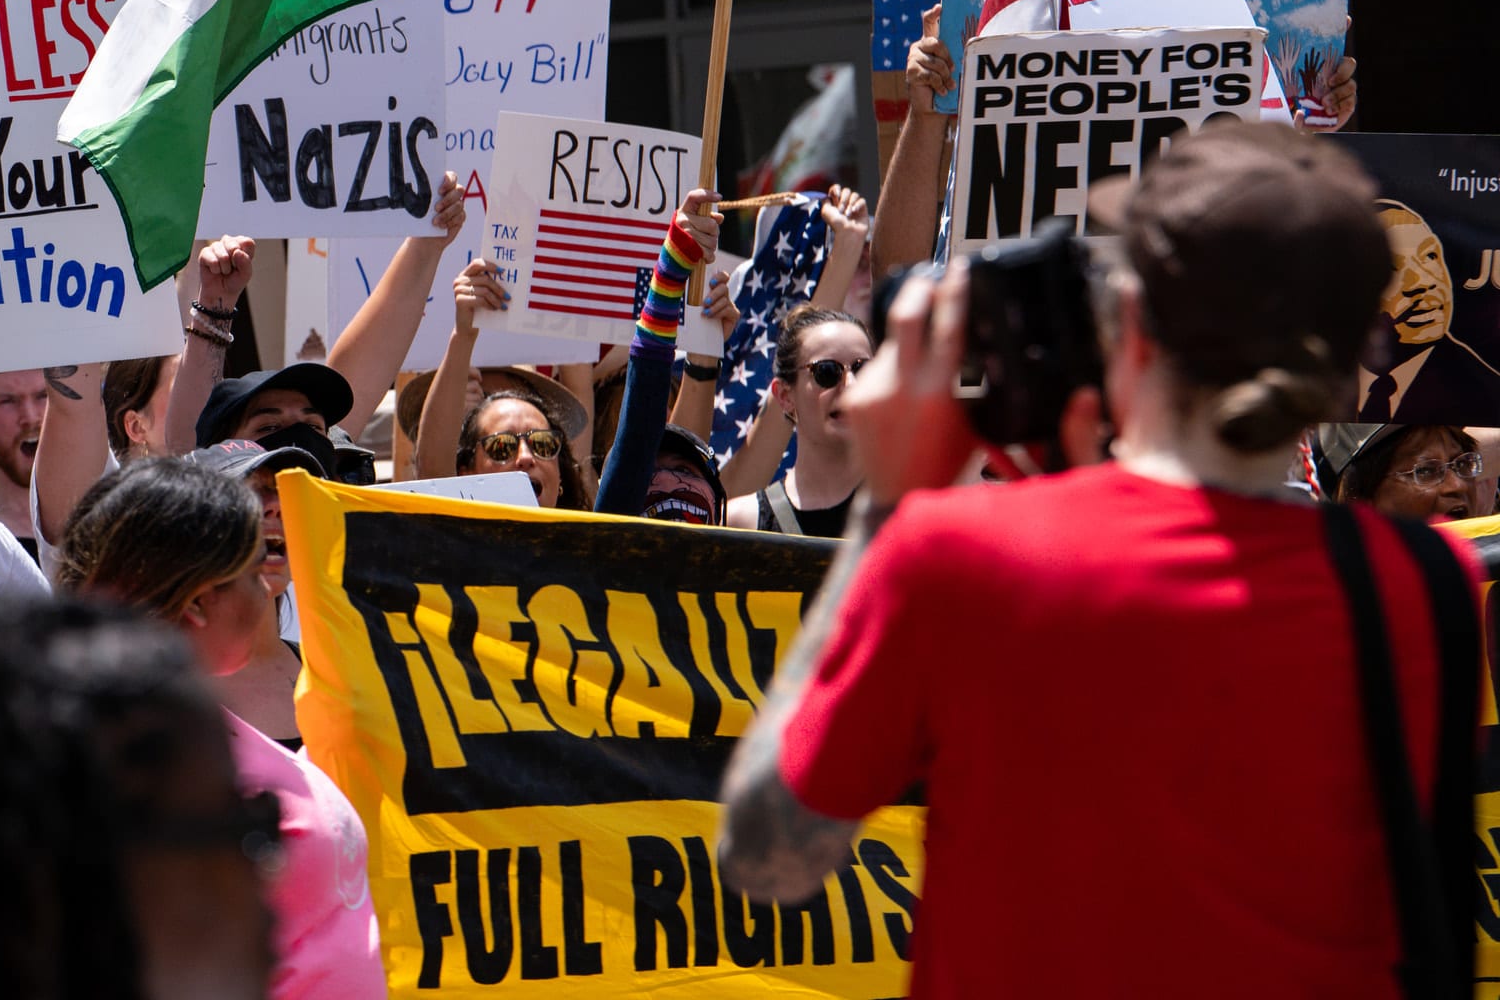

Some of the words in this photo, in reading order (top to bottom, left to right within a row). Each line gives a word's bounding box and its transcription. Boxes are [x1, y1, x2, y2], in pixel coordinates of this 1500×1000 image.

[976, 47, 1154, 81] MONEY
[1160, 41, 1253, 73] FOR
[973, 73, 1252, 118] PEOPLE'S
[234, 96, 438, 219] Nazis
[548, 129, 689, 215] RESIST
[965, 112, 1242, 240] NEE
[491, 224, 519, 241] TAX
[493, 246, 517, 262] THE
[409, 841, 603, 989] FULL
